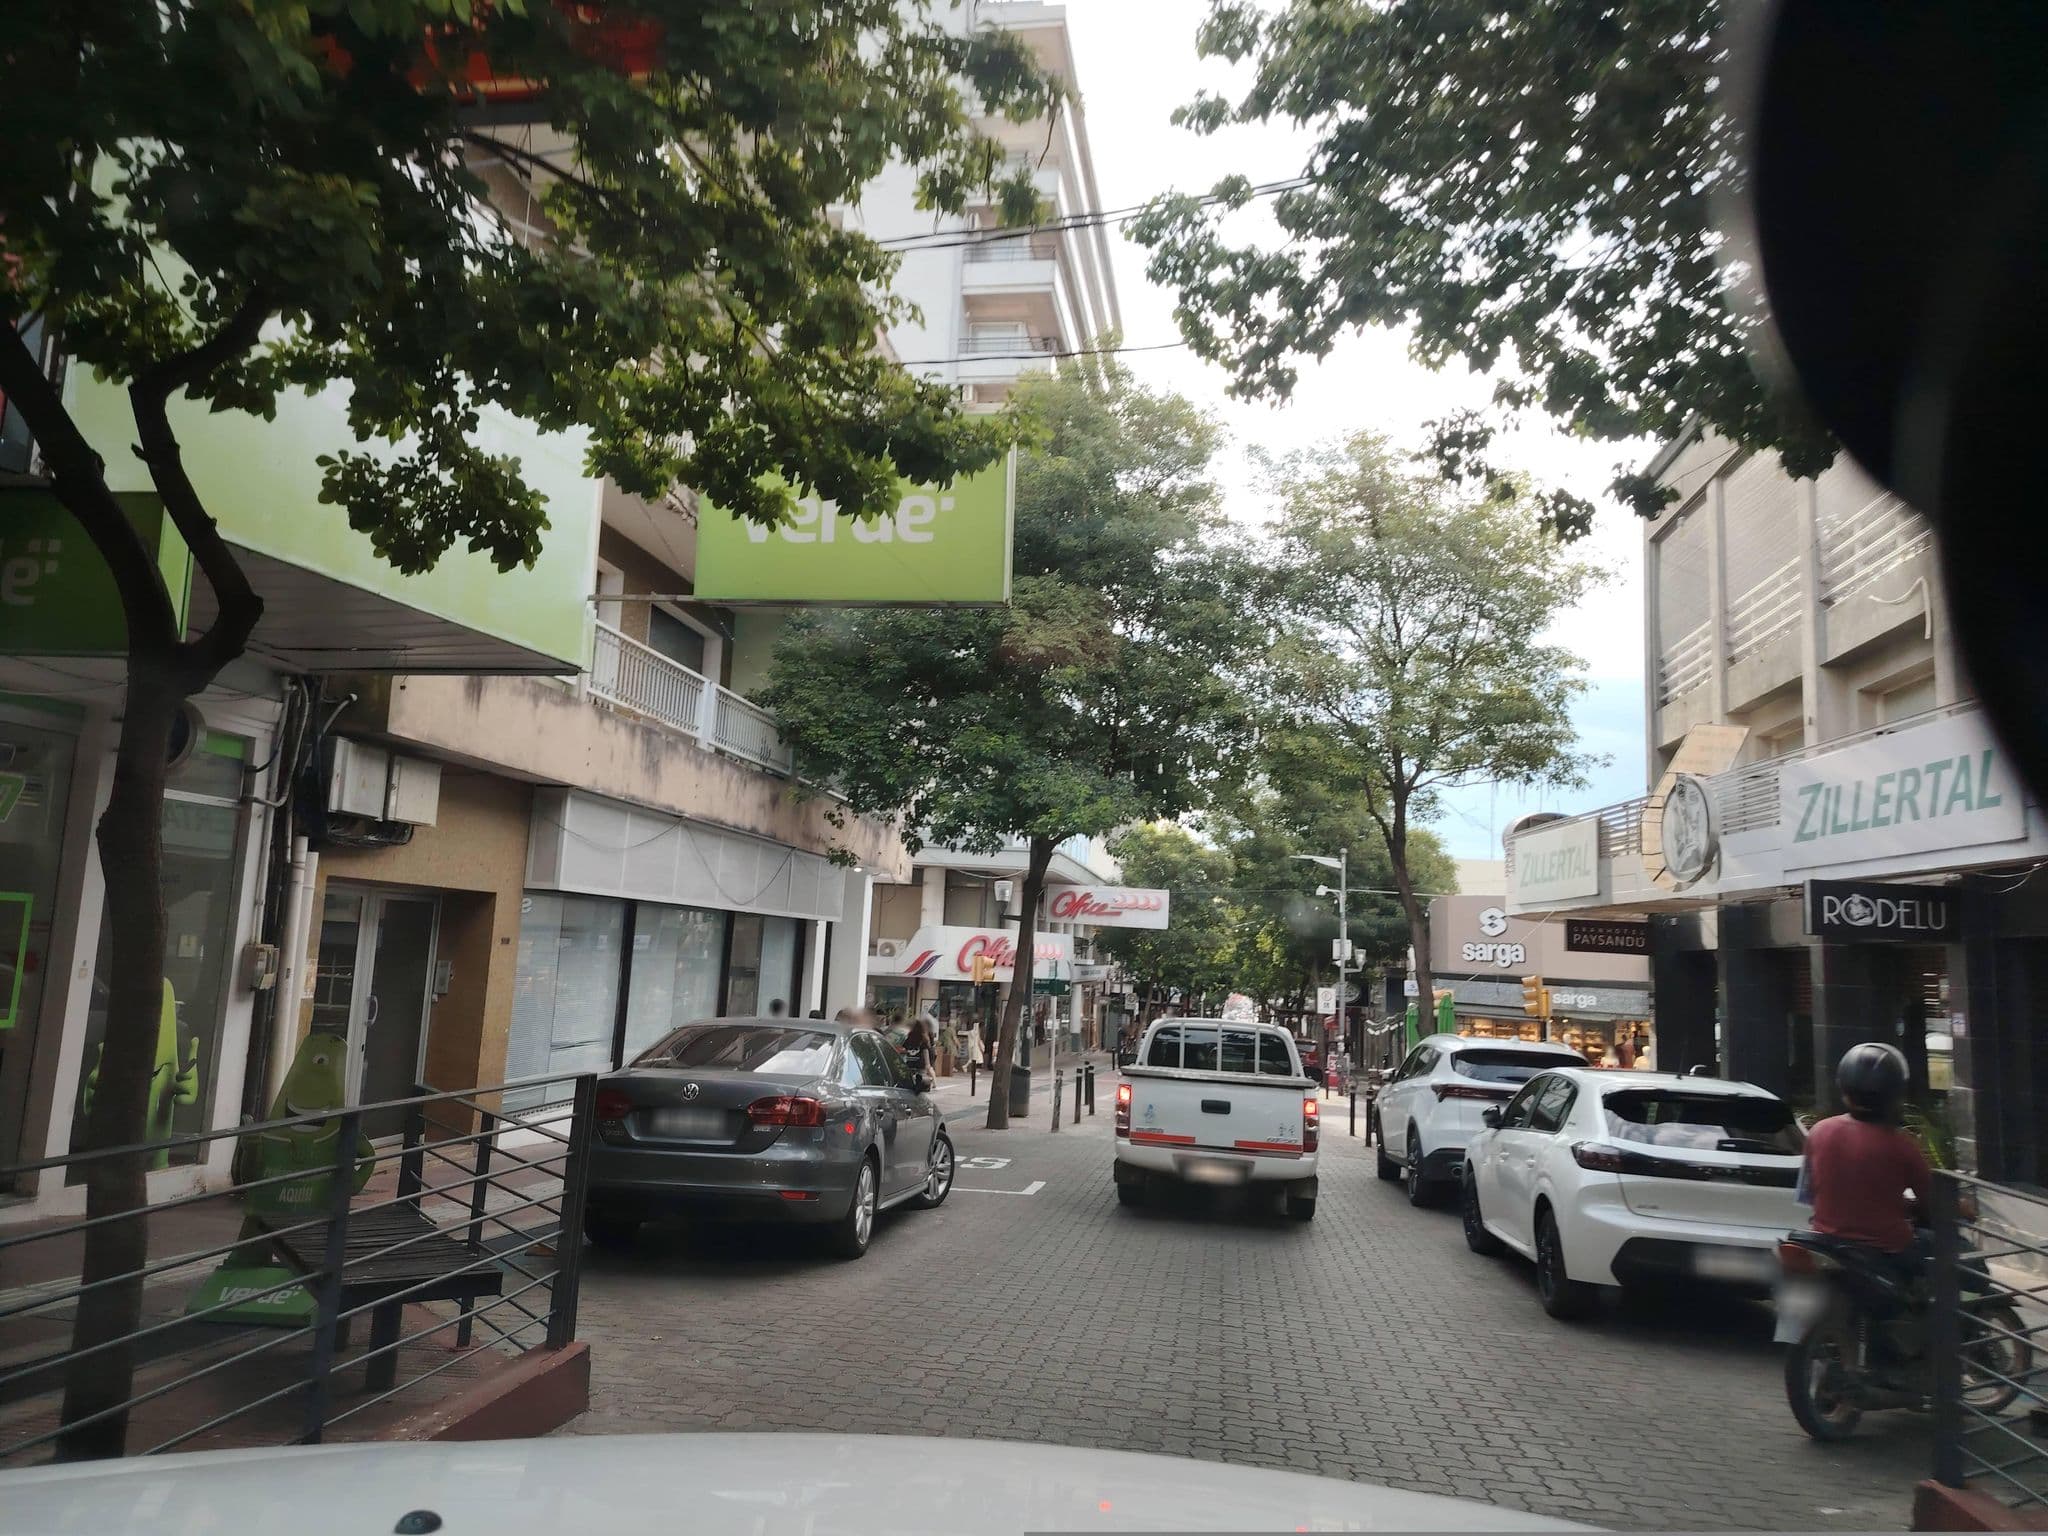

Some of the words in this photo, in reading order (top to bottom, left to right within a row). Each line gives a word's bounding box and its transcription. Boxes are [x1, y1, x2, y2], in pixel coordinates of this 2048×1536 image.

[1793, 748, 2002, 844] ZILLERTAL
[1519, 842, 1592, 888] ZILLERTAL
[1051, 890, 1122, 919] Office
[1822, 894, 1948, 931] RODELU
[1462, 942, 1526, 968] sarga
[1553, 993, 1597, 1008] sarga
